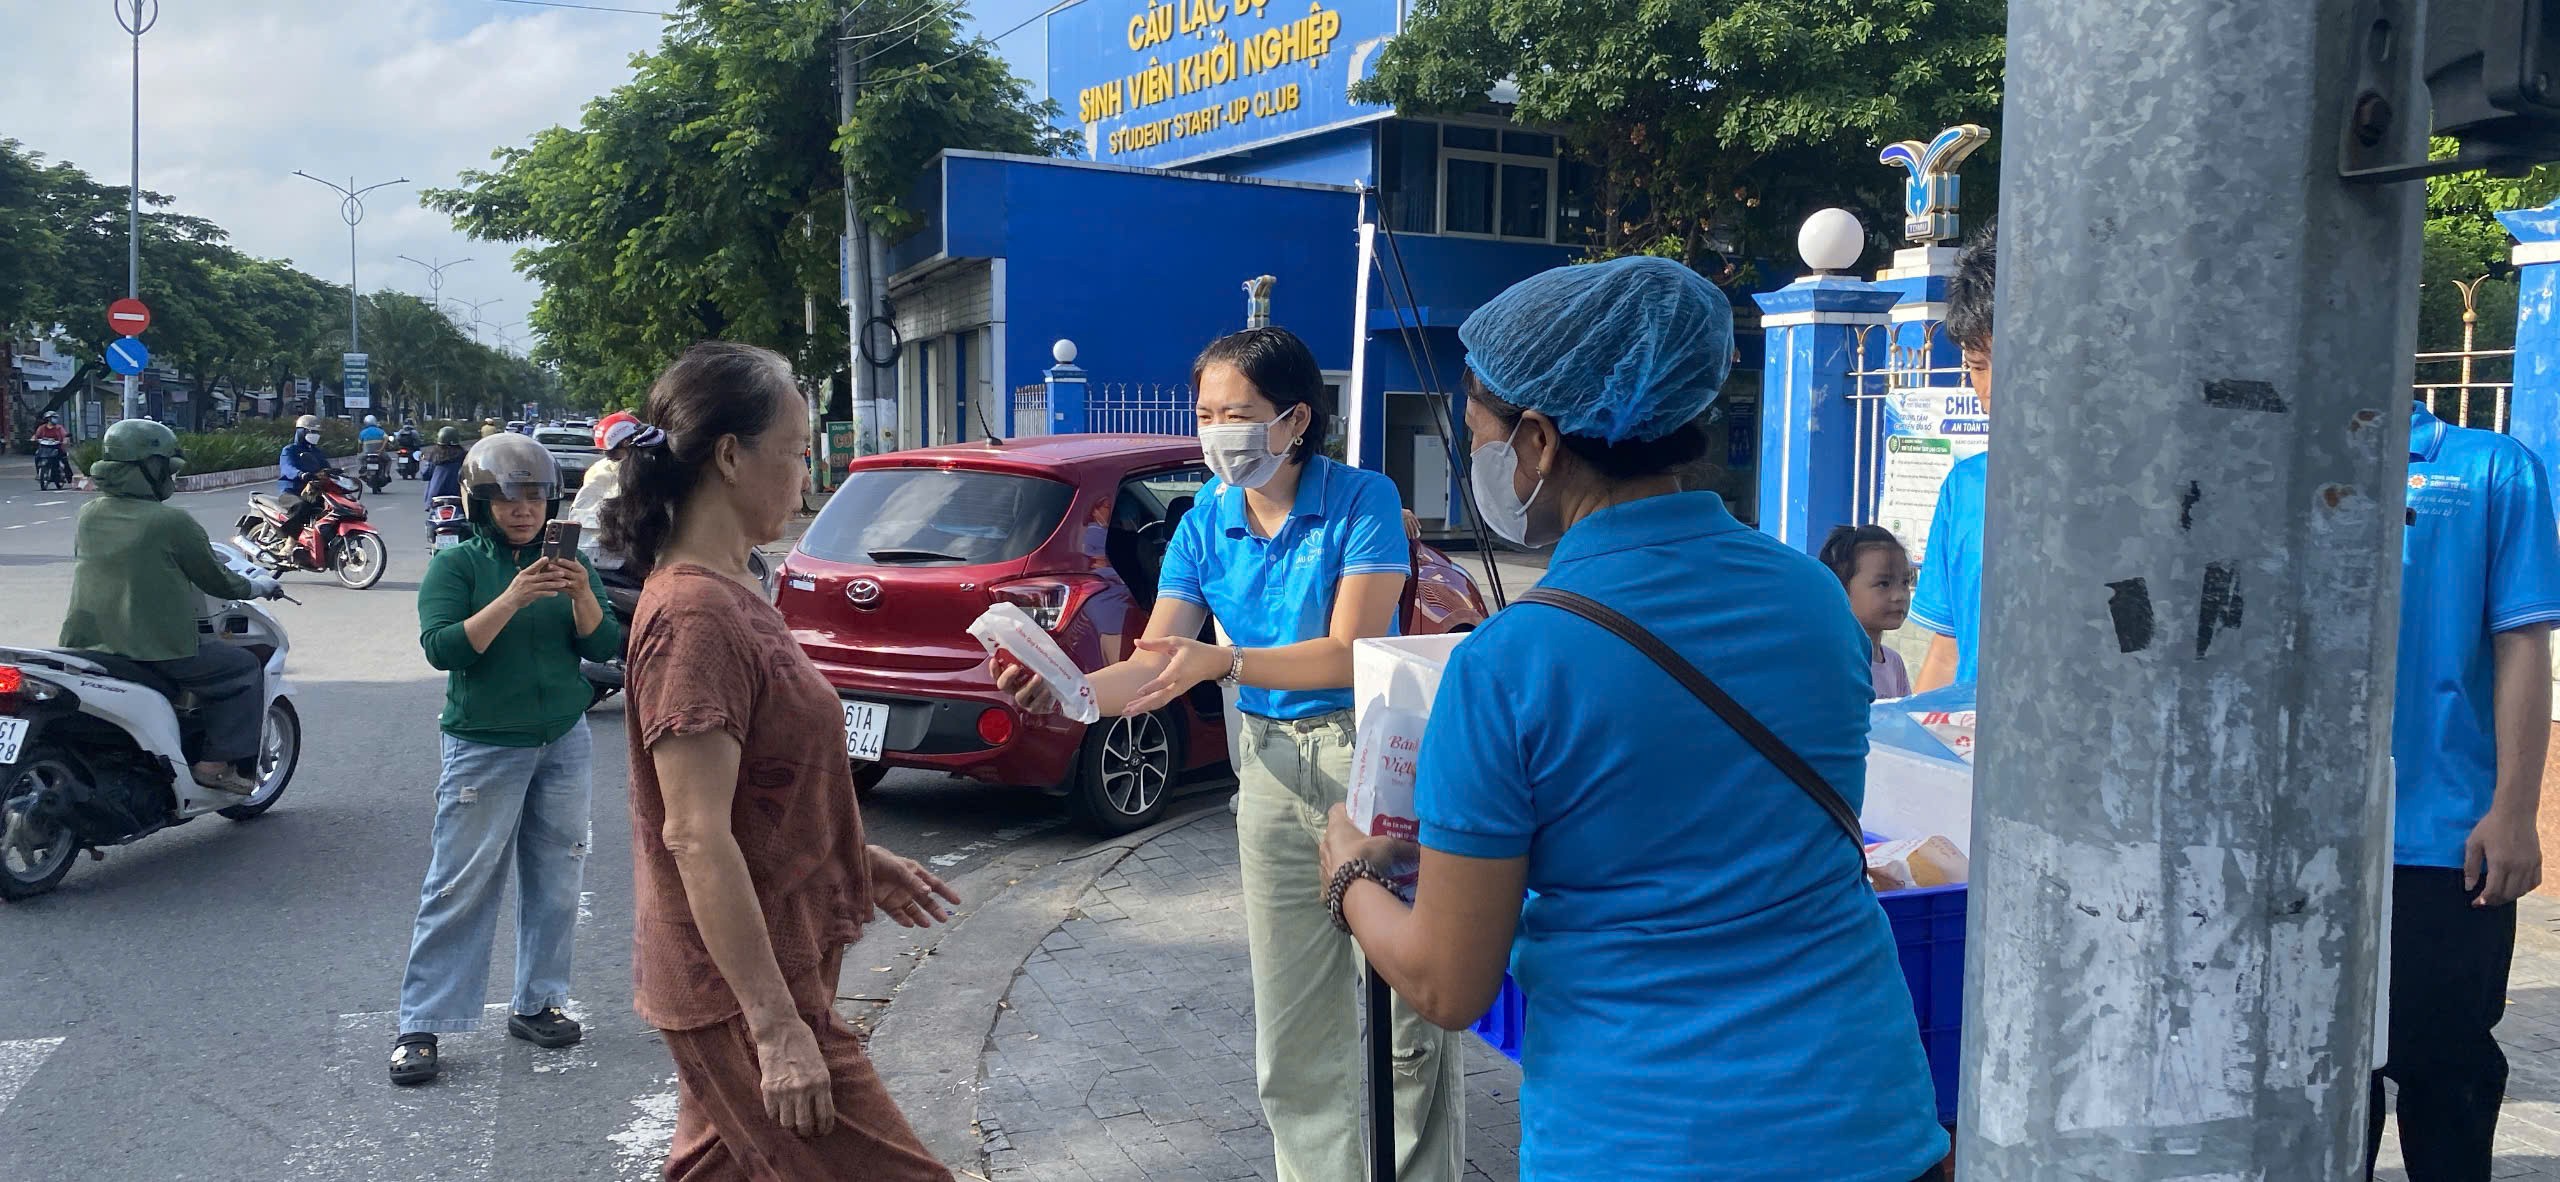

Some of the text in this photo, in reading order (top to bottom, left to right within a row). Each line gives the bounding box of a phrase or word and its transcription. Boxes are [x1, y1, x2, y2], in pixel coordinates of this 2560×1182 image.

[1080, 1, 1339, 123] SINH VIÊN KHỞI NGHIỆP
[1109, 118, 1173, 154] STUDENT
[1254, 83, 1299, 118] CLUB
[1951, 423, 1962, 432] AN
[1963, 420, 1980, 432] TOÀN
[845, 705, 872, 730] 61A
